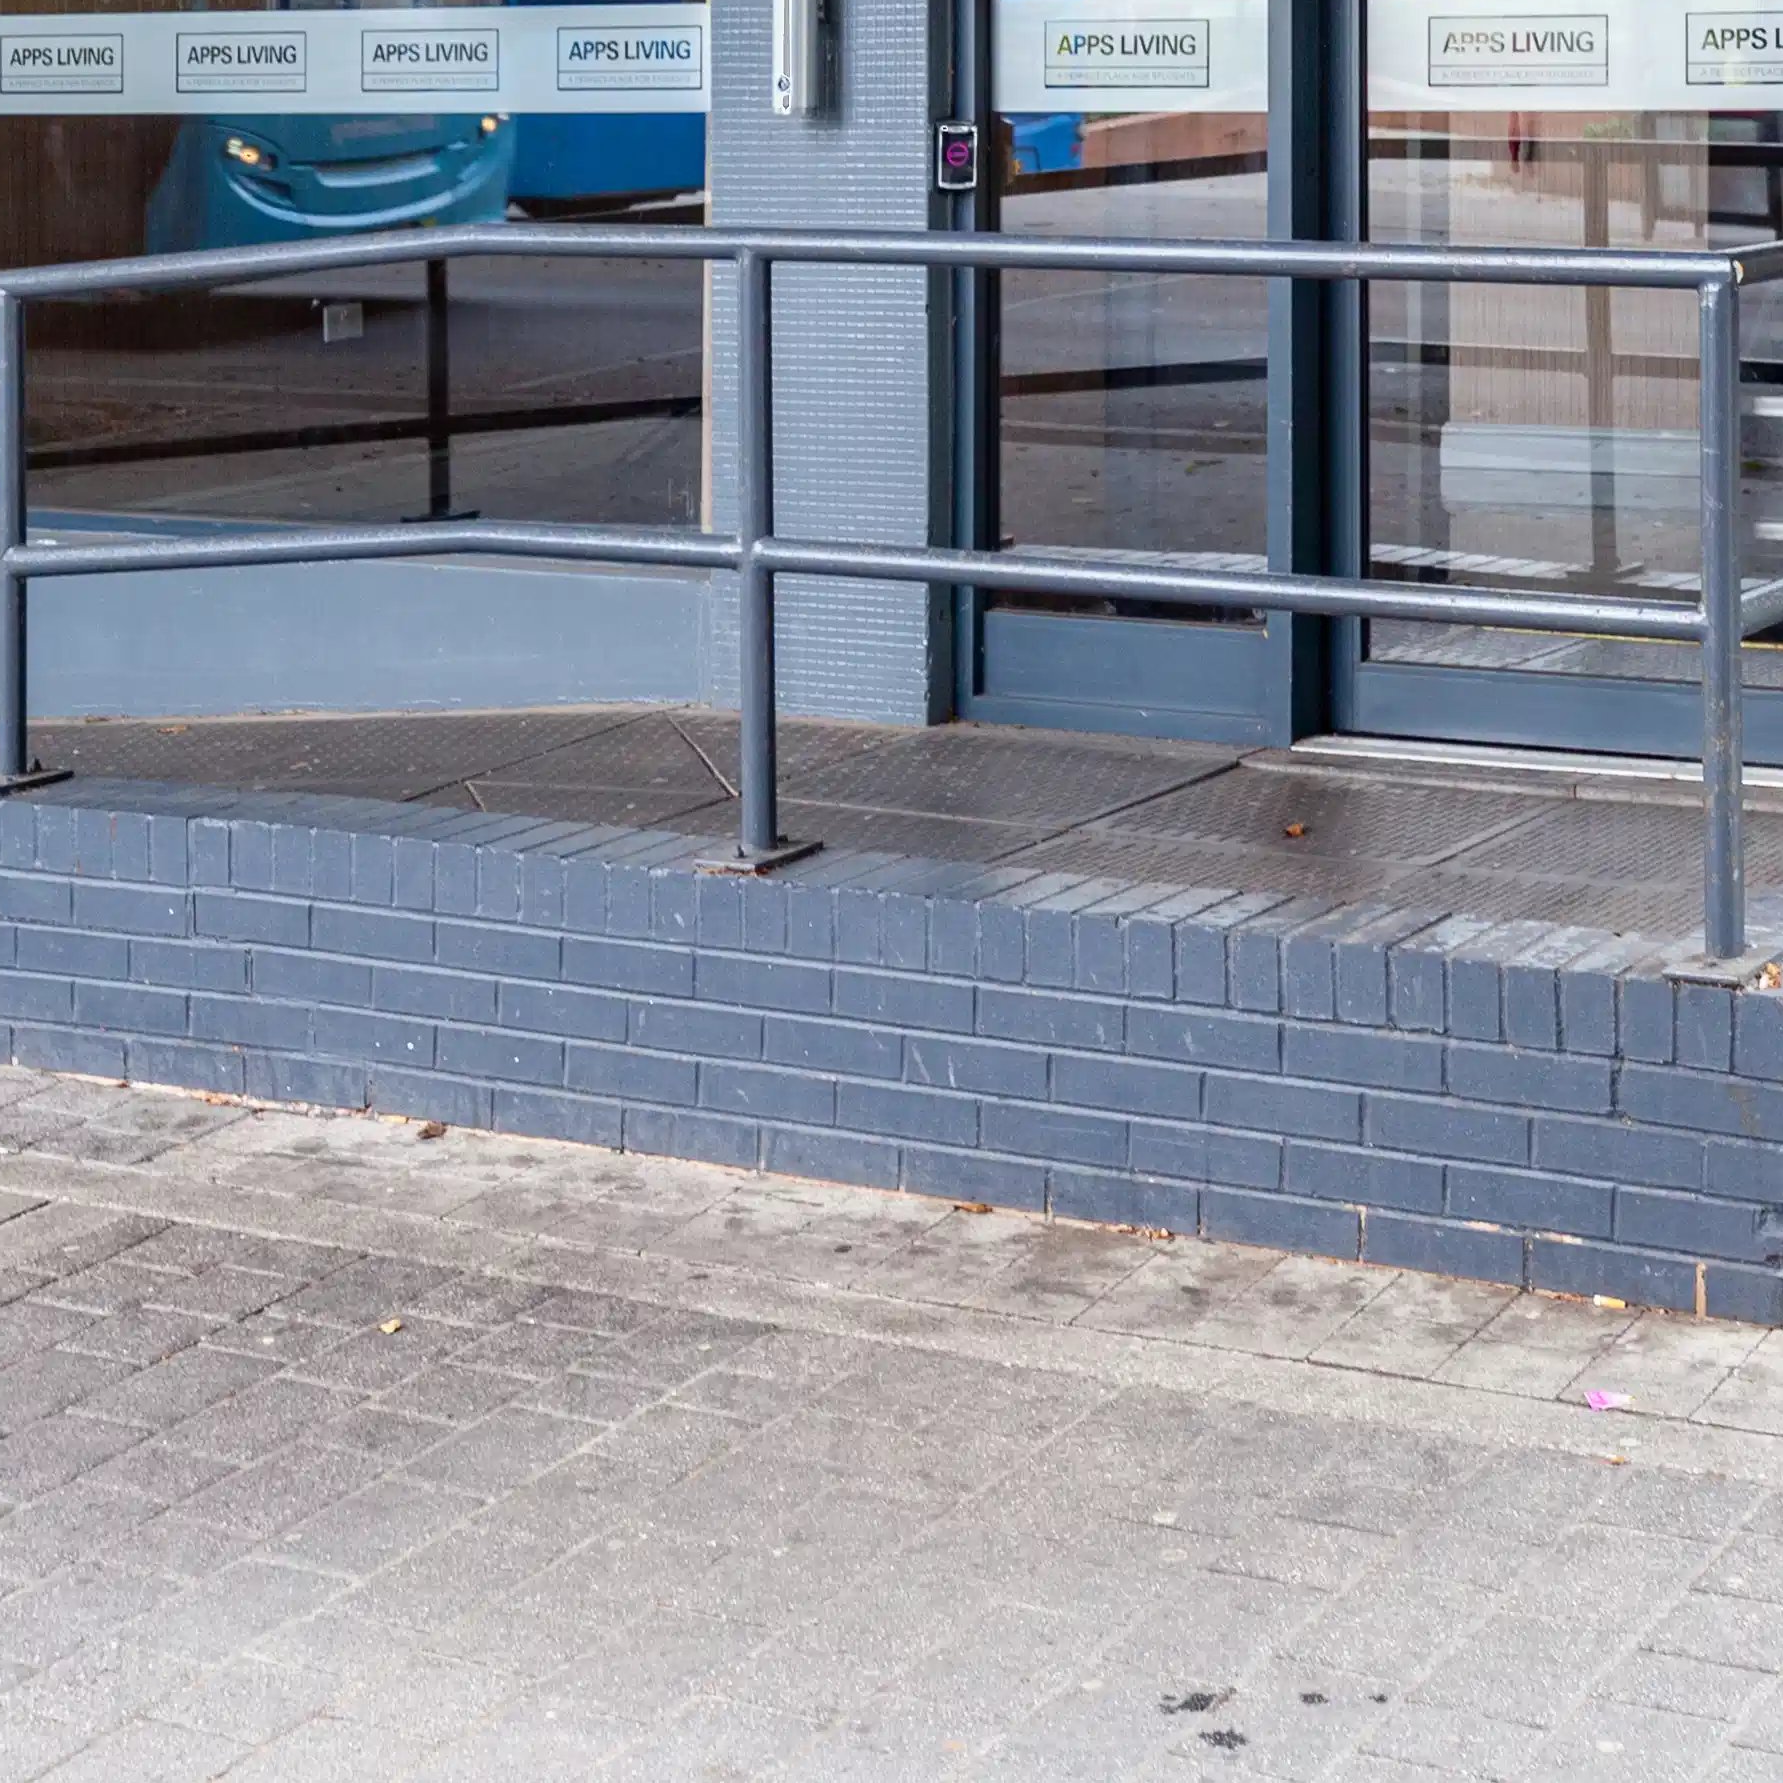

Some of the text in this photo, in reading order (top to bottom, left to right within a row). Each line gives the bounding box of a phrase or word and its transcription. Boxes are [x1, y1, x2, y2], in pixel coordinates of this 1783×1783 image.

[1057, 34, 1196, 56] APPS LIVING
[1442, 30, 1594, 53] APPS LIVING
[1701, 27, 1767, 50] APPS
[10, 47, 114, 67] APPS LIVING
[187, 44, 296, 64] APPS LIVING
[372, 42, 488, 62] APPS LIVING
[568, 39, 691, 61] APPS LIVING
